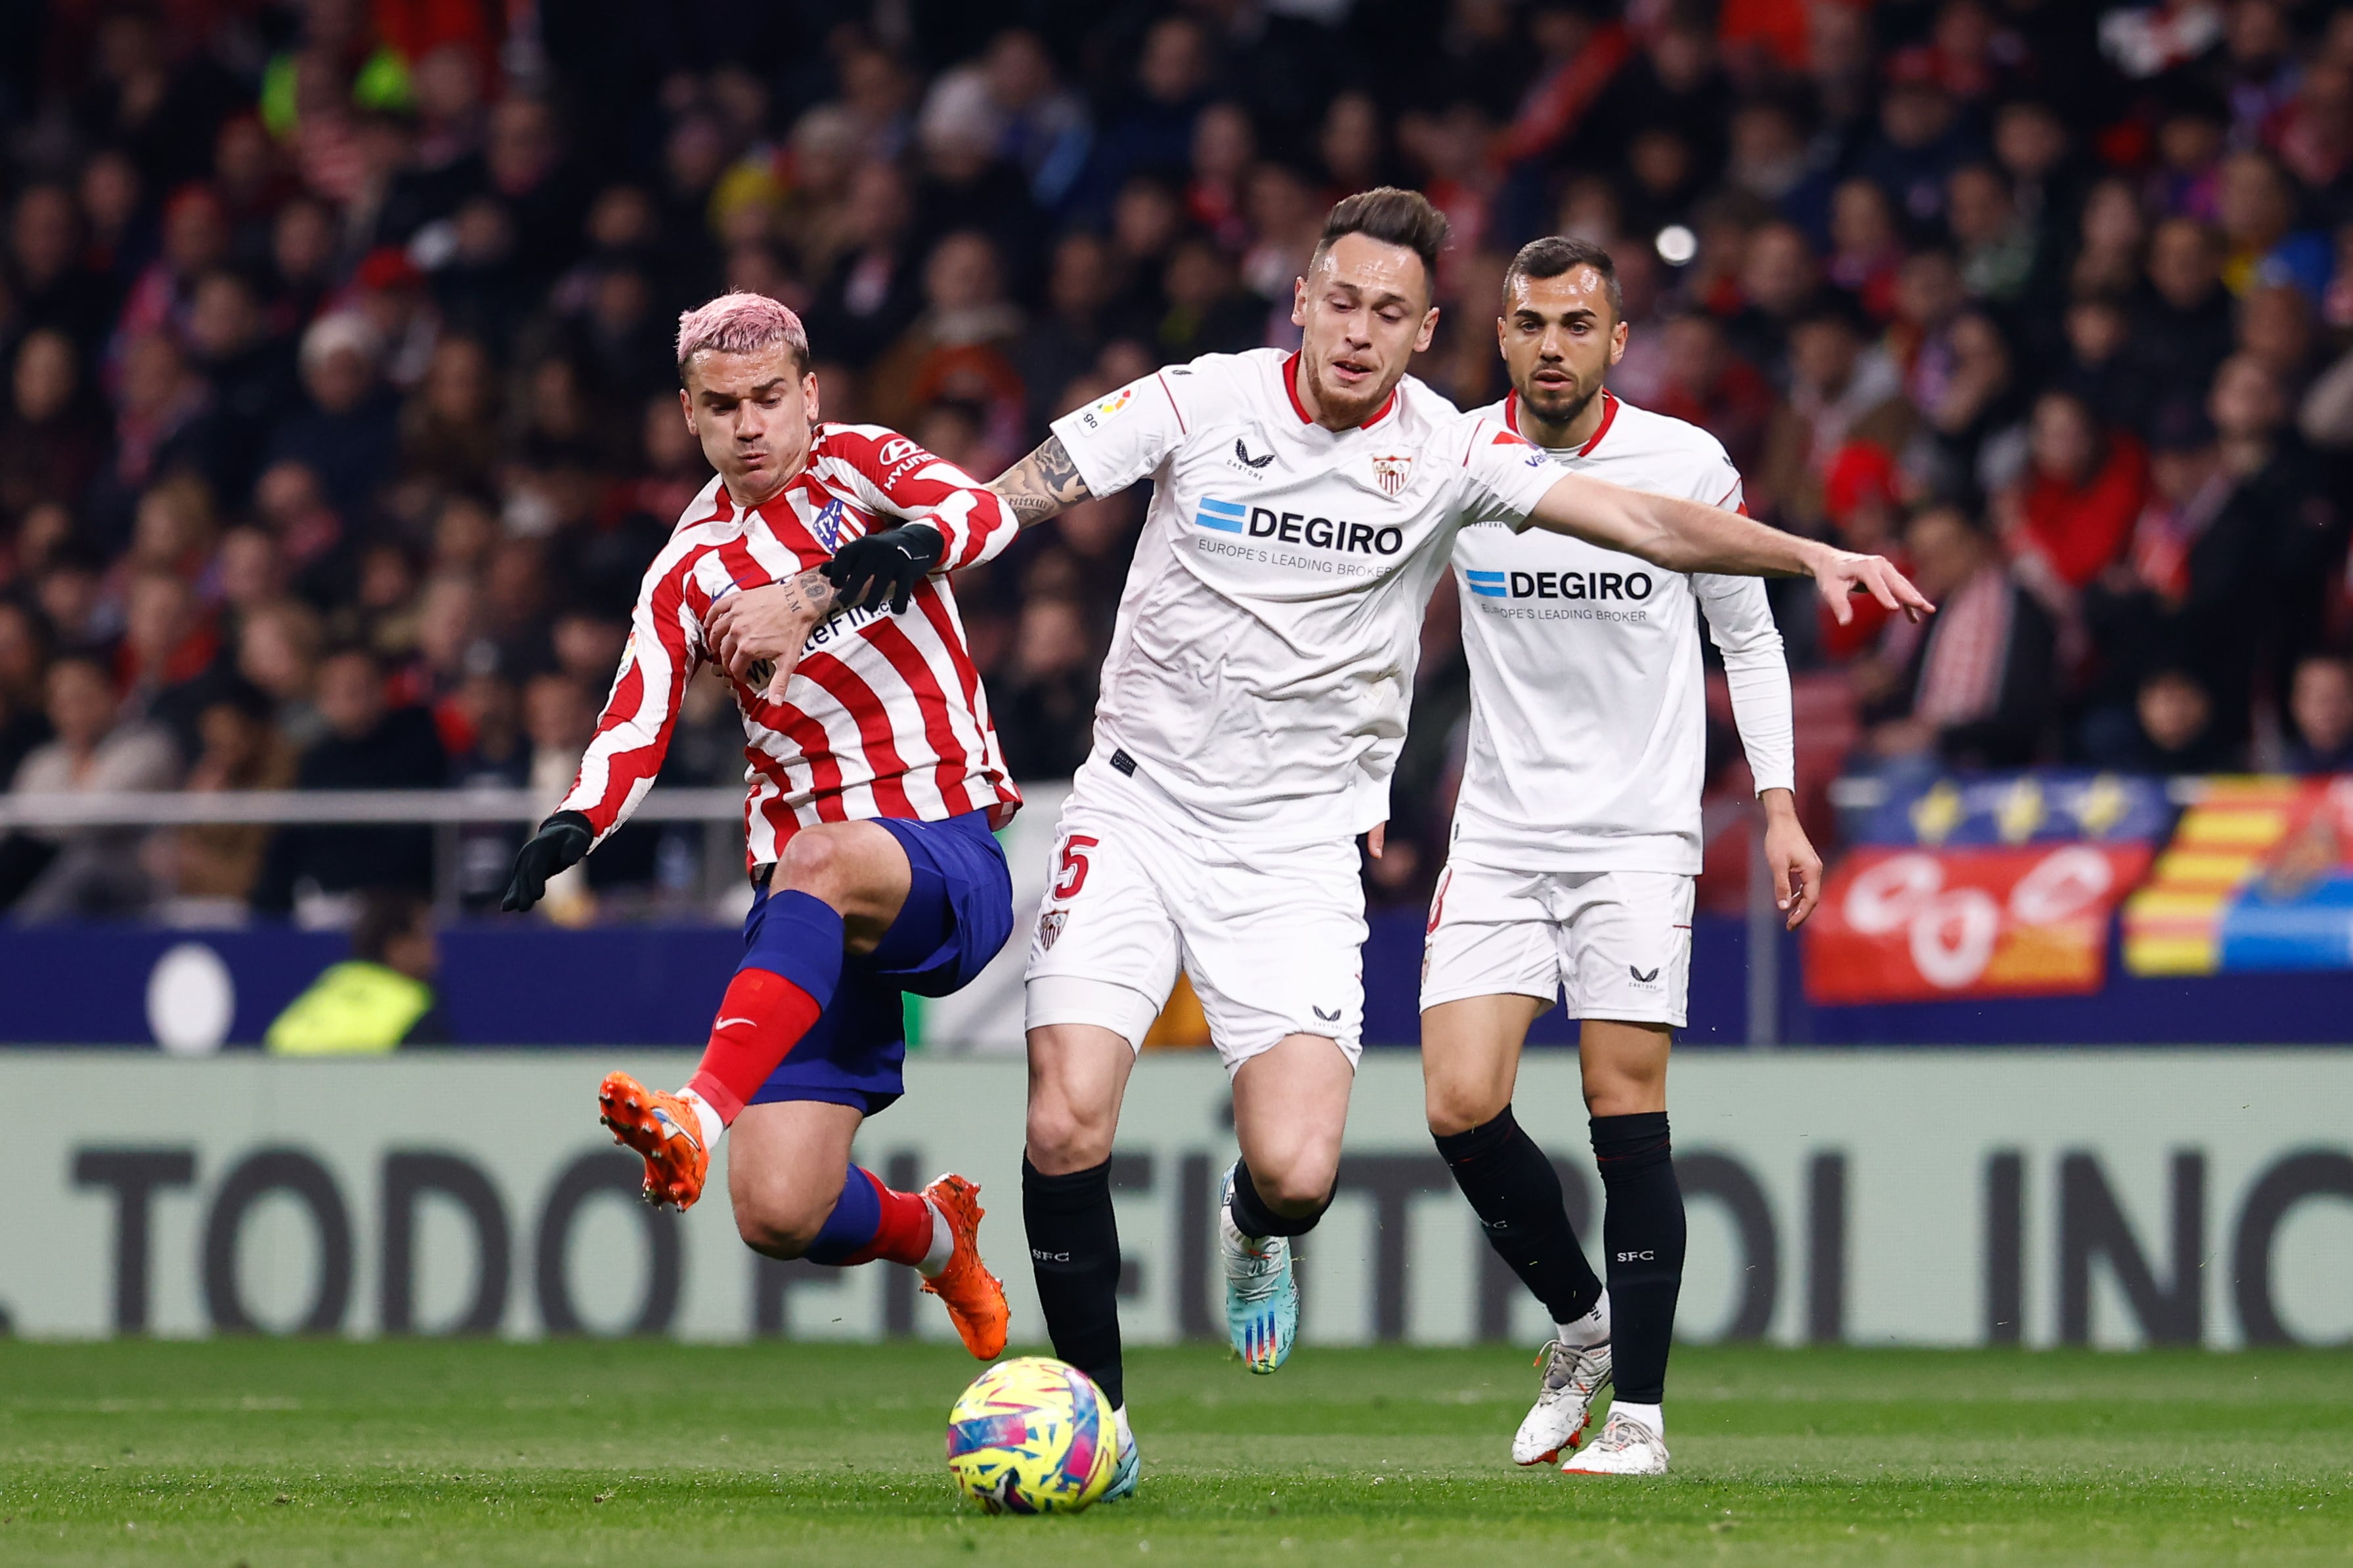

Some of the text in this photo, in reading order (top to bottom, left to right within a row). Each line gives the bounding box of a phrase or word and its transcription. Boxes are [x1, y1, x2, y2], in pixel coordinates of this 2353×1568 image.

[1249, 507, 1404, 555] DEGIRO
[1198, 539, 1267, 562] EUROPE'S
[1272, 553, 1333, 573] LEADING
[1510, 572, 1652, 600] DEGIRO
[1538, 609, 1593, 620] LEADING
[1596, 610, 1647, 622] BROKER
[1051, 834, 1100, 902] 5
[74, 1145, 684, 1332] TODO
[1032, 1248, 1069, 1262] SFC
[1617, 1250, 1654, 1262] SFC
